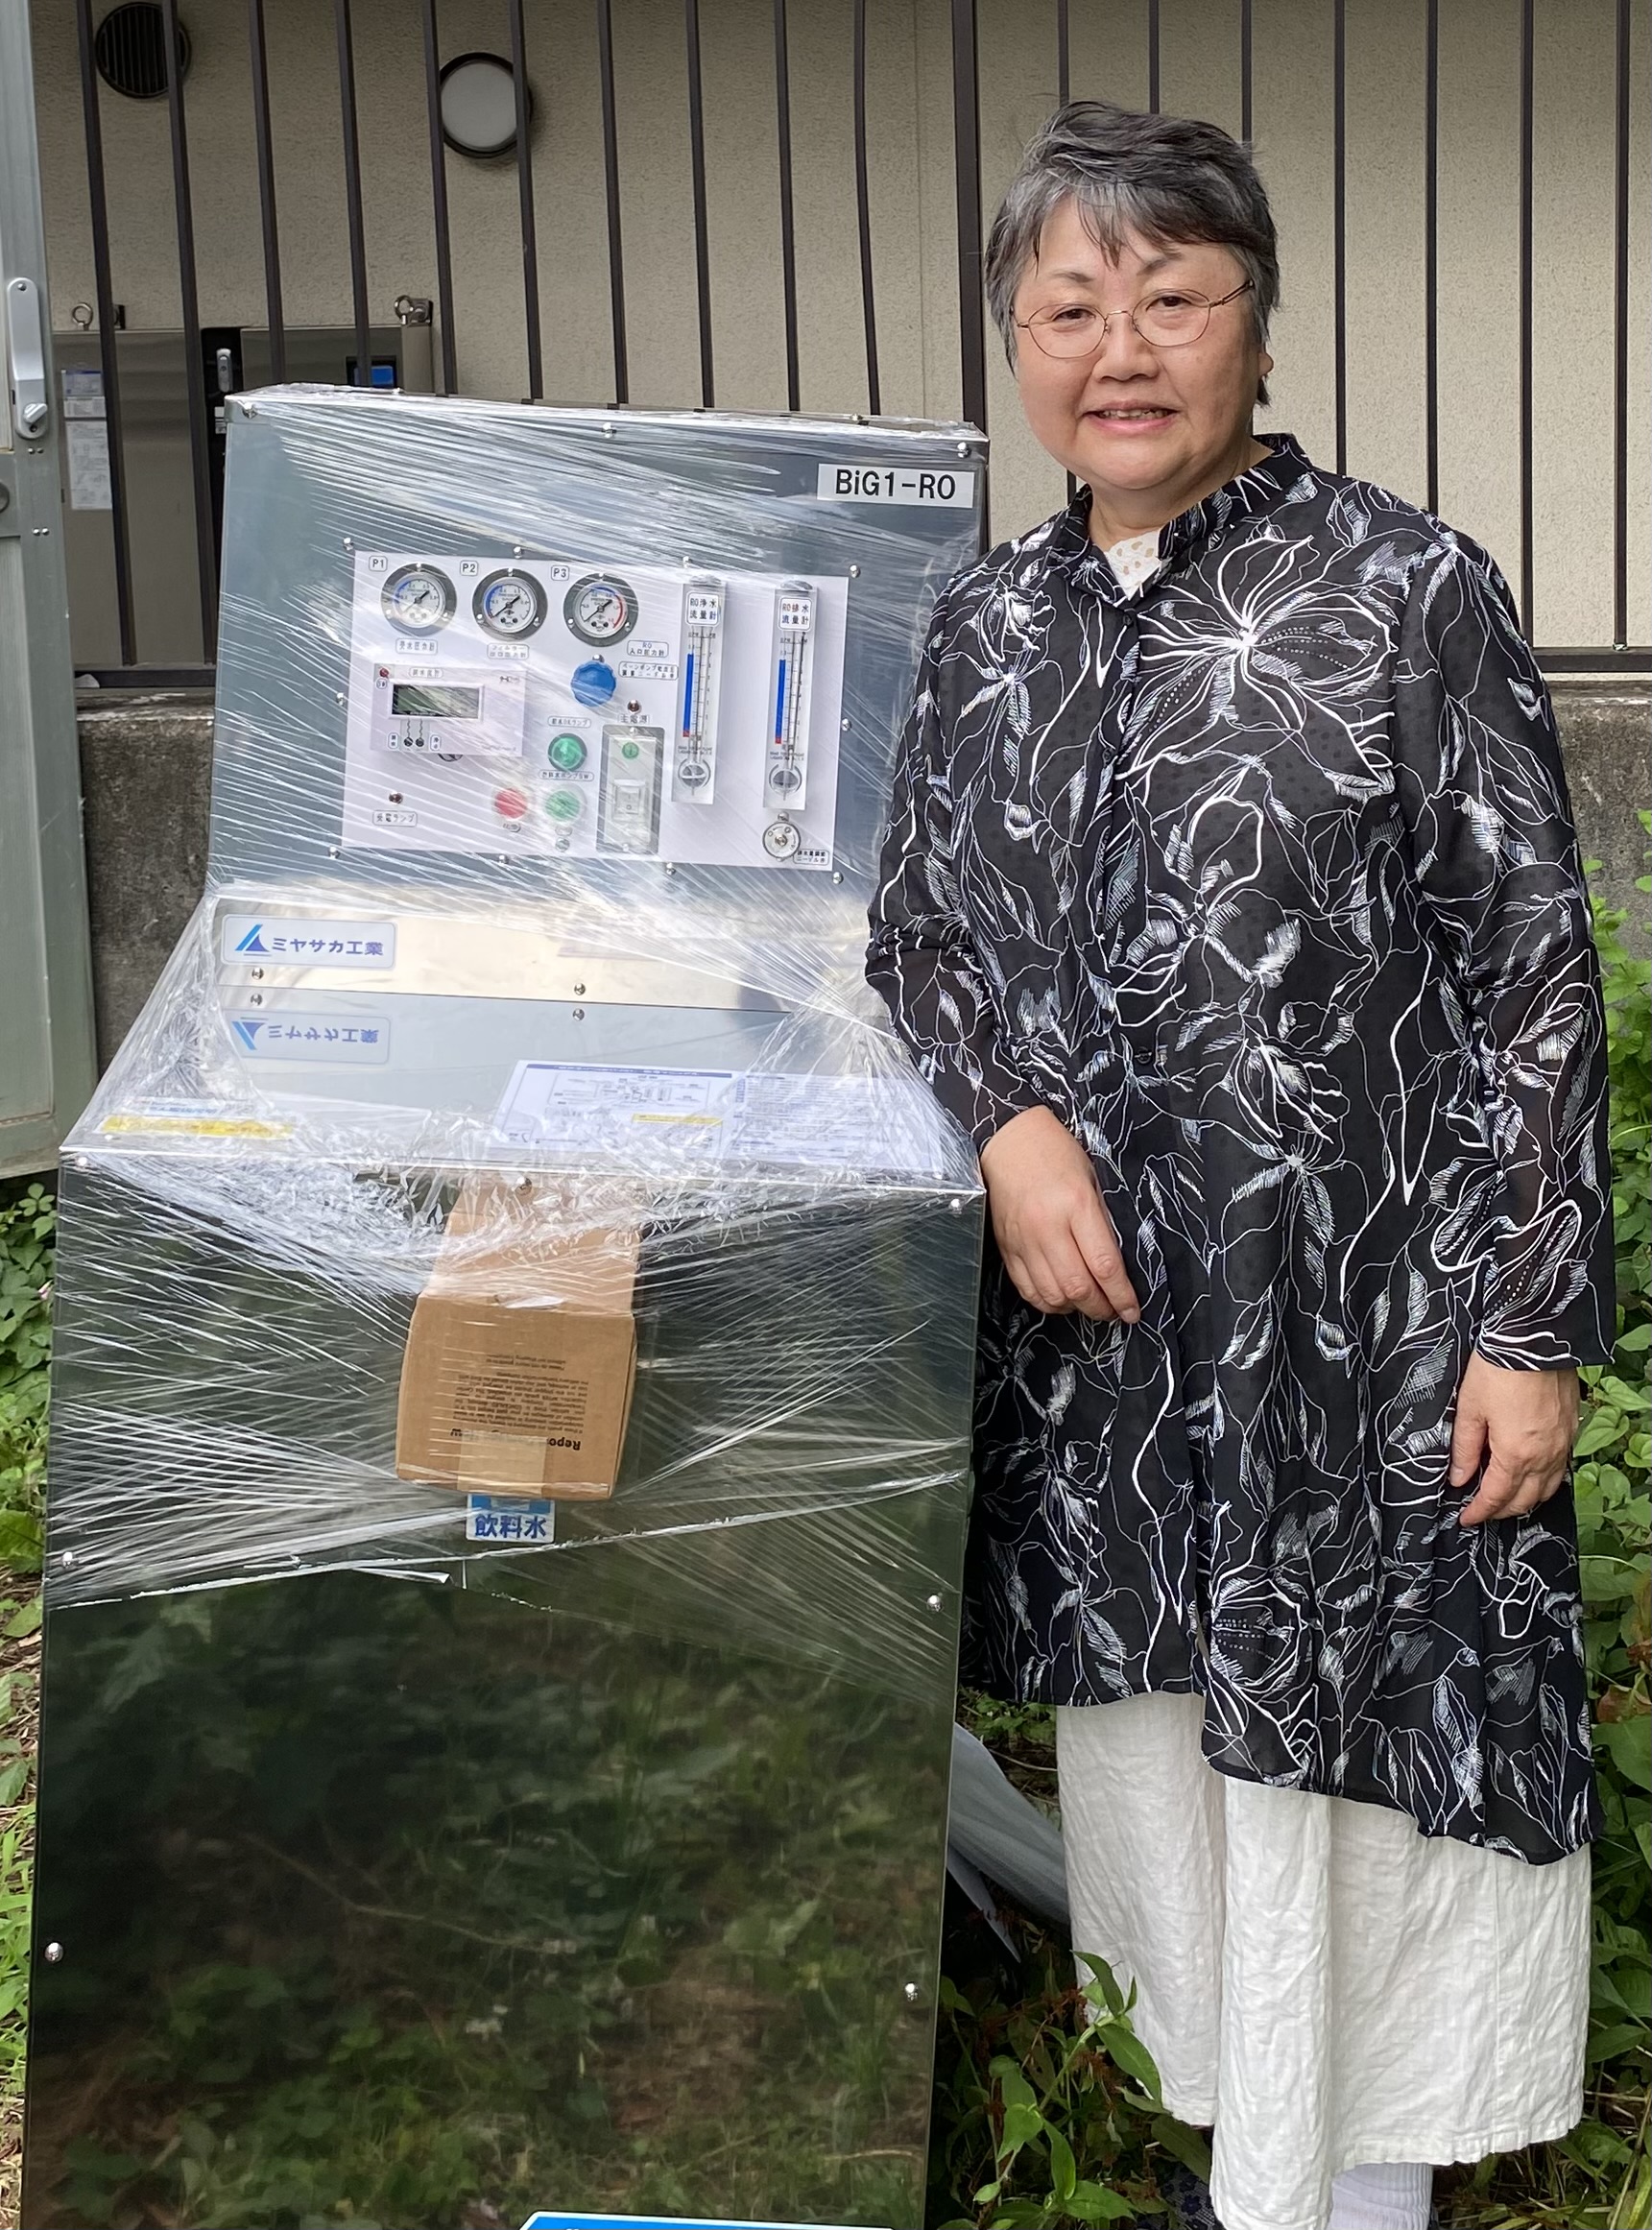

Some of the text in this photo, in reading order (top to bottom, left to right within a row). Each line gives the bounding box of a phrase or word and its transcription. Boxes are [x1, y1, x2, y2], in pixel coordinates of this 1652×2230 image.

[835, 468, 956, 500] BiG1-RO
[371, 559, 384, 568] P1
[462, 563, 476, 573] P2
[553, 567, 567, 578] P3
[272, 937, 384, 956] ミヤサカ工業
[546, 1436, 582, 1451] Repo
[474, 1515, 547, 1540] 飲料水
